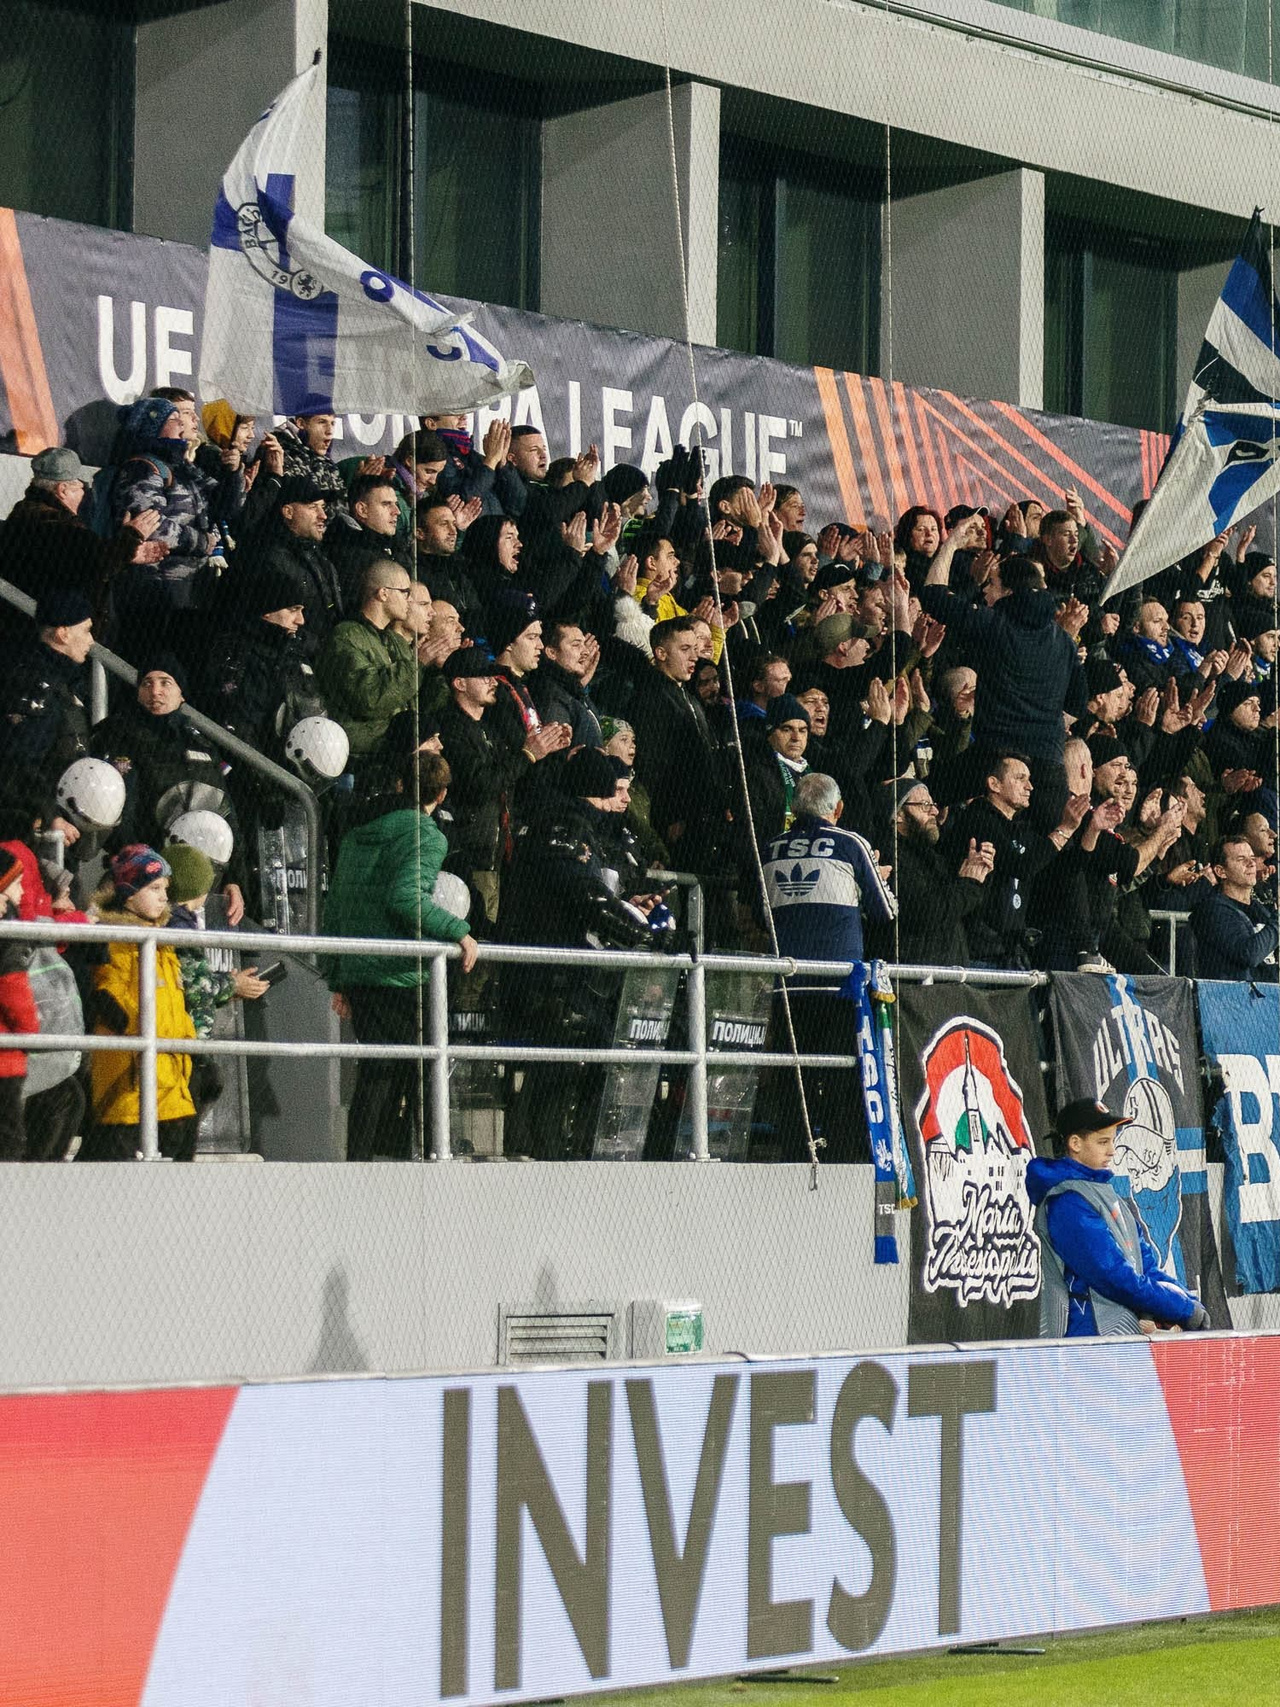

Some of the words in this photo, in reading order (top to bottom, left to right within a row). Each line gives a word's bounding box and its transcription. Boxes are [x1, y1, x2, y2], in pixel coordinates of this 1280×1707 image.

[769, 837, 836, 860] TSC
[1092, 1004, 1185, 1101] ULTRAS
[440, 1360, 998, 1701] INVEST
